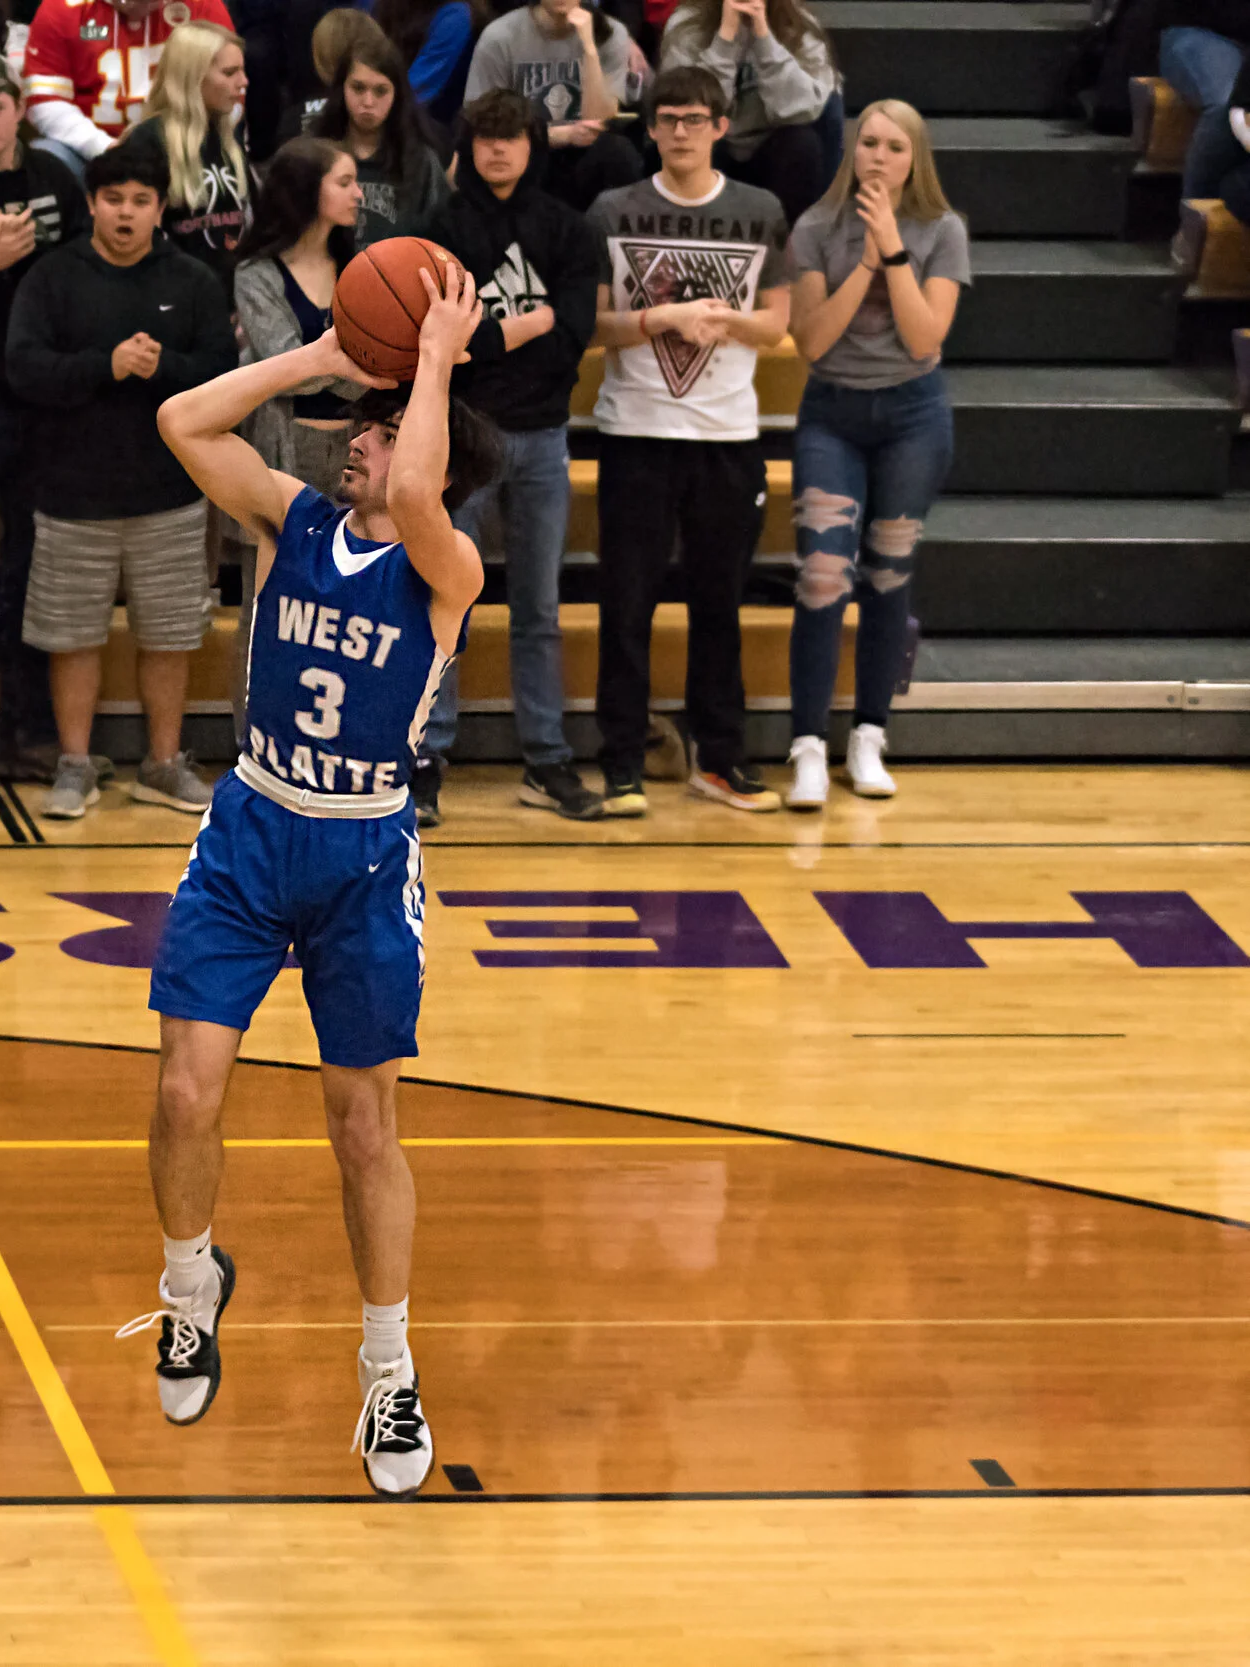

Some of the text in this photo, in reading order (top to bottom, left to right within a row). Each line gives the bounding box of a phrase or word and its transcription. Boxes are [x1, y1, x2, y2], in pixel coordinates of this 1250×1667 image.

[618, 213, 765, 243] AMERICAN
[277, 595, 401, 669] WEST
[294, 666, 346, 740] 3
[249, 724, 398, 794] PLATTE
